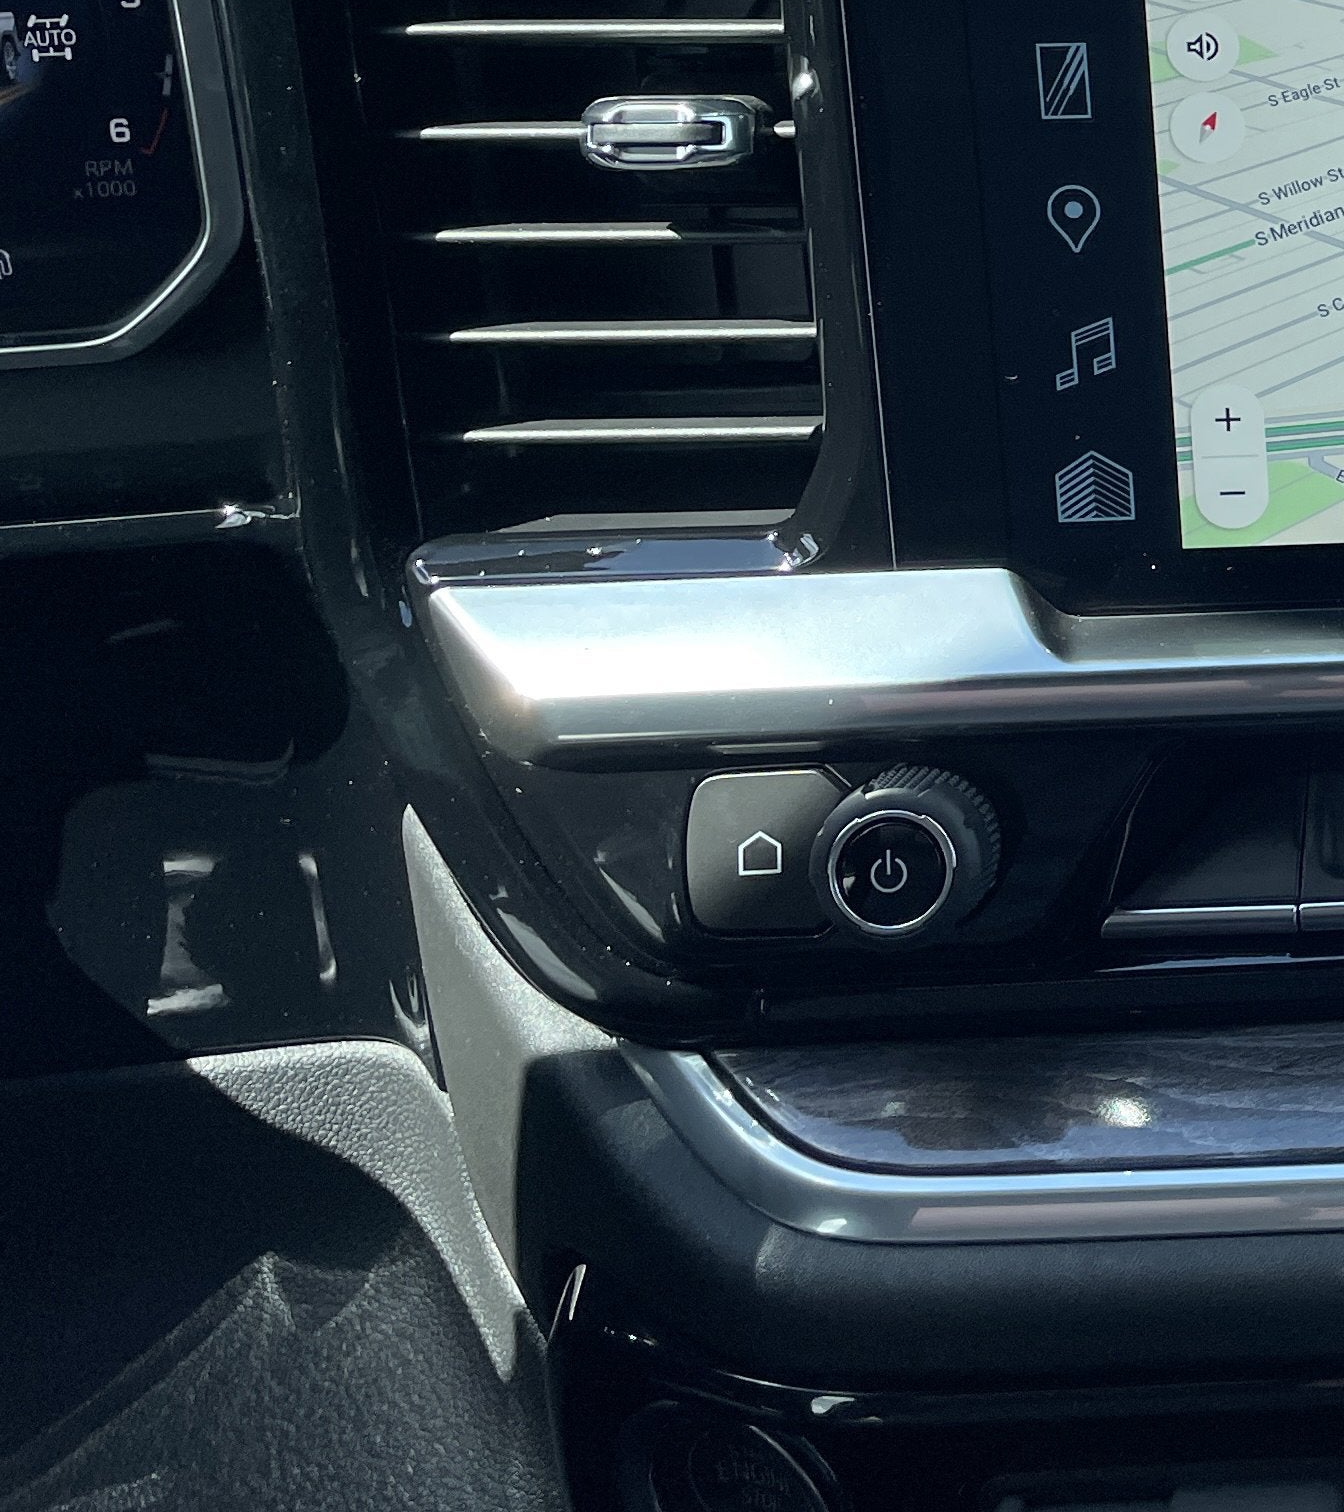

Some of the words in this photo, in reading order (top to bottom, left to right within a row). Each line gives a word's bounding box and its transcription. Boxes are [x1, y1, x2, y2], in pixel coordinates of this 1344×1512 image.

[24, 29, 77, 47] AUTO
[1268, 95, 1278, 106] S
[1282, 85, 1320, 102] Eagle
[1324, 78, 1338, 90] St
[109, 118, 130, 143] 6
[85, 159, 133, 177] RPM
[1259, 192, 1270, 205] S
[1272, 178, 1324, 200] Willow
[1327, 168, 1344, 182] St
[1255, 232, 1268, 245] S
[1270, 208, 1344, 240] Meridian
[1318, 304, 1329, 317] S
